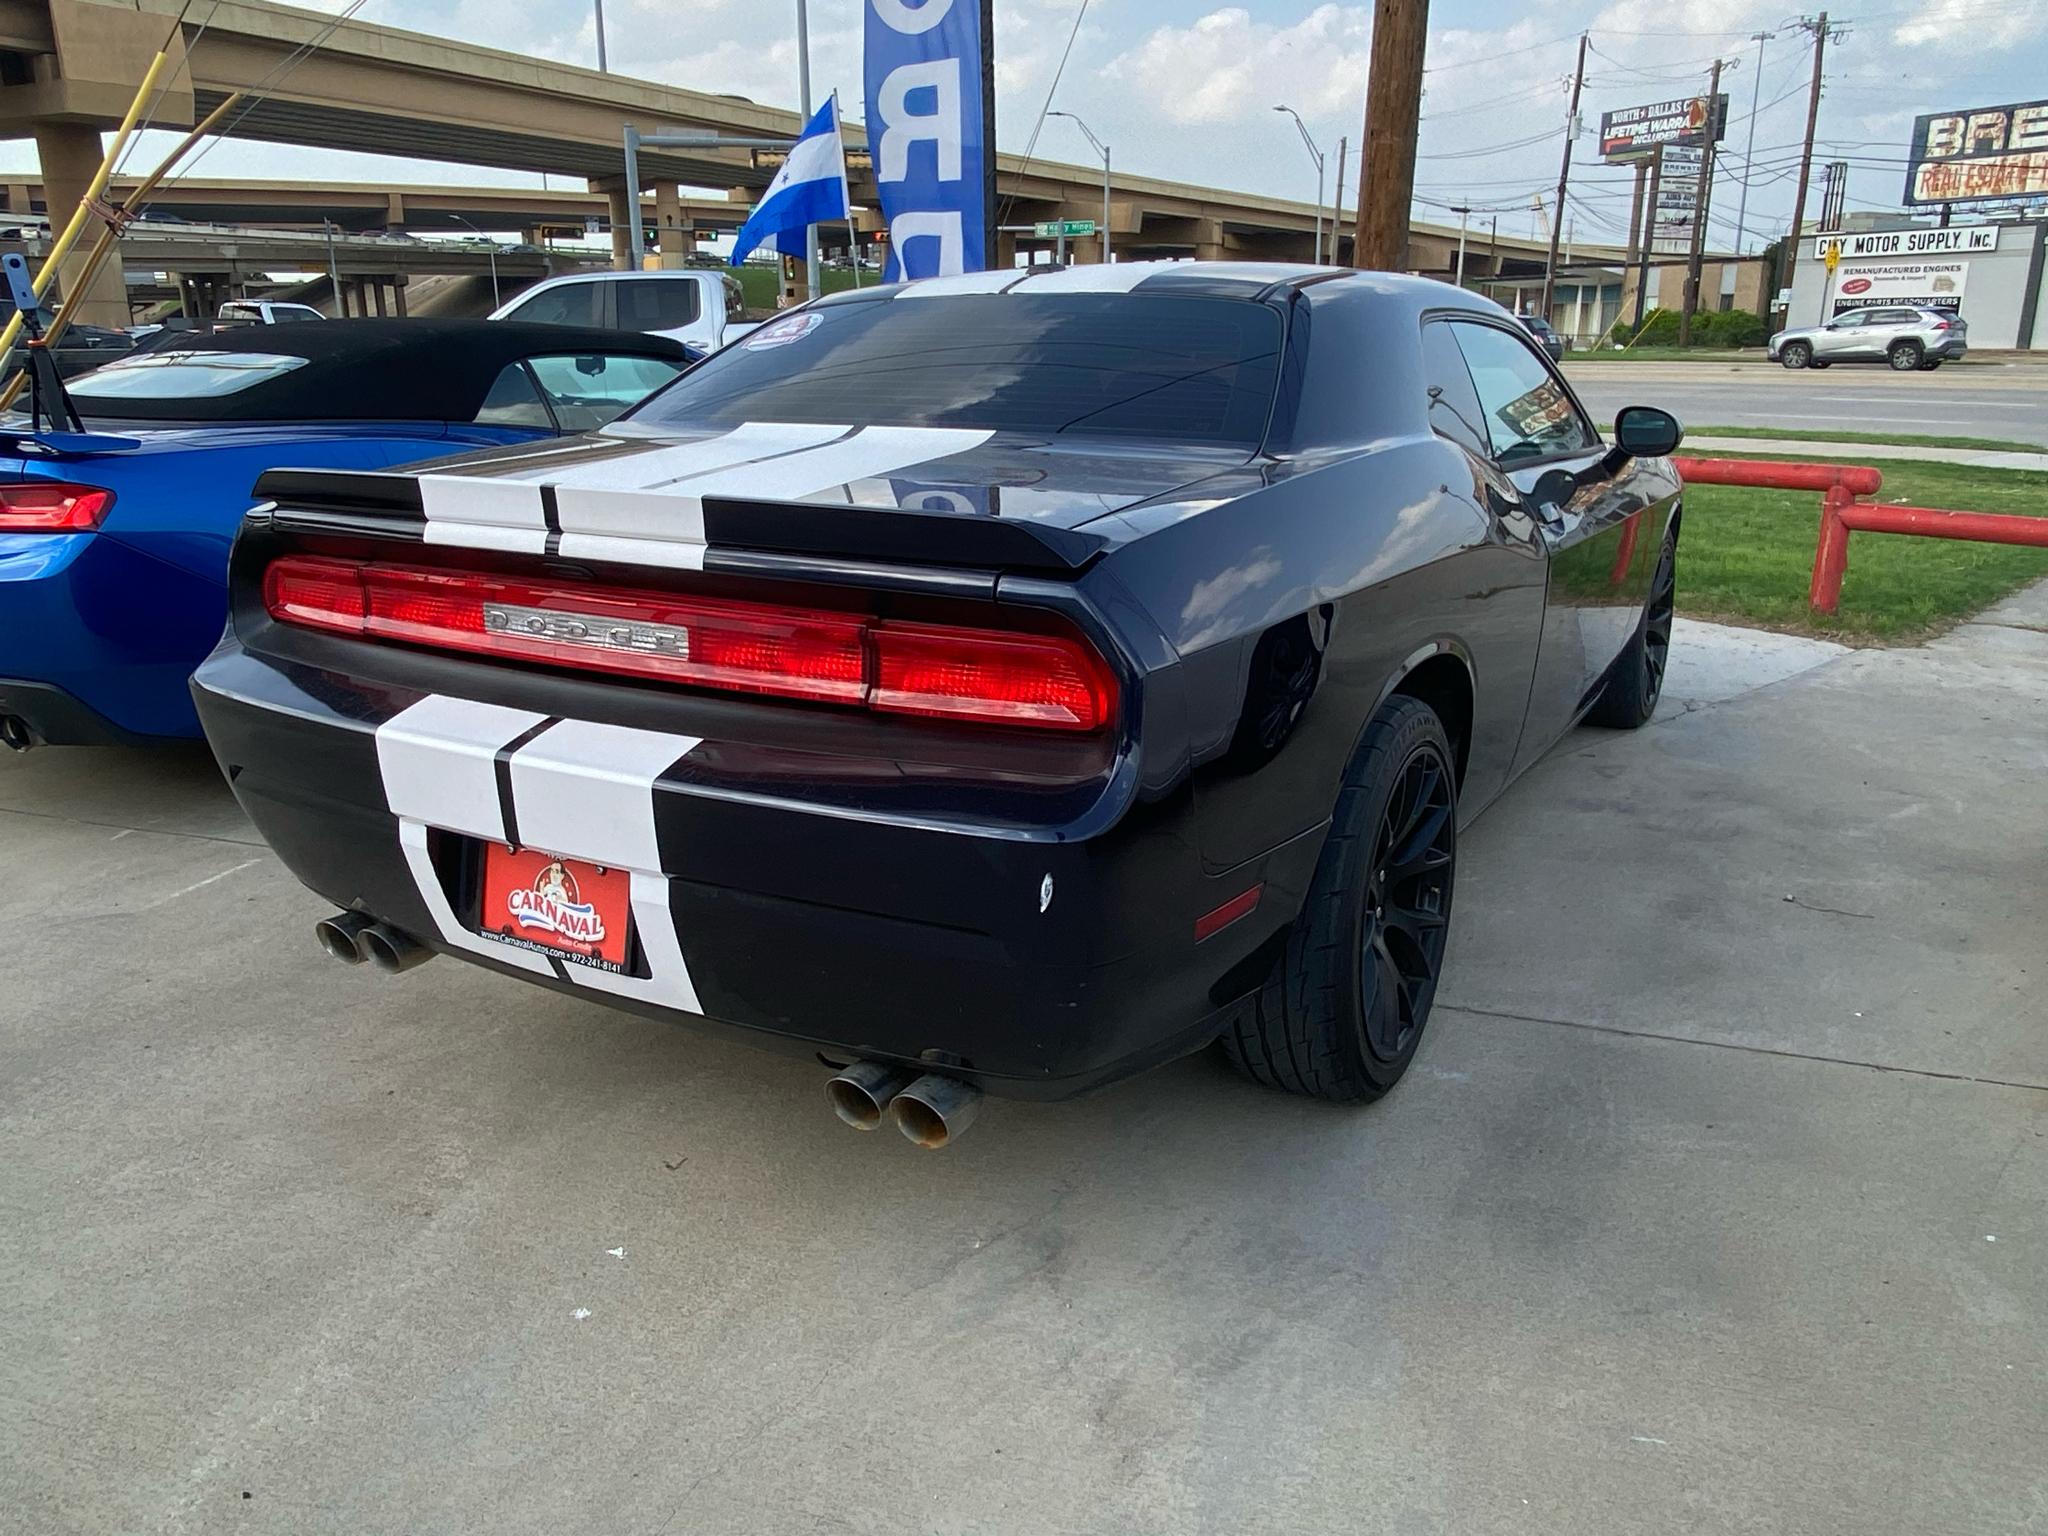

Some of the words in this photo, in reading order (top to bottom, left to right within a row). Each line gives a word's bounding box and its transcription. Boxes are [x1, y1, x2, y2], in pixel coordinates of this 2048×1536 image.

[1611, 108, 1640, 124] NORTH
[1648, 101, 1682, 119] DALLAS
[1603, 121, 1651, 139] LIFETIME
[1651, 115, 1691, 133] WARRA
[1632, 130, 1680, 145] INCLUDED!
[1920, 164, 1963, 193] REAL
[1048, 223, 1070, 233] Hay
[1855, 235, 1900, 253] MOTOR
[1843, 265, 1922, 276] REMANUFACTURED
[1923, 264, 1962, 274] ENGINES
[1836, 298, 1865, 308] ENGINE
[1866, 298, 1892, 307] PARTS
[1893, 296, 1959, 307] HEADQUARTERS
[489, 610, 677, 649] DODGE
[508, 890, 605, 939] CARNAVAL
[480, 929, 566, 960] www.CarnavalAutos.com
[571, 952, 621, 974] 972-241-8141
